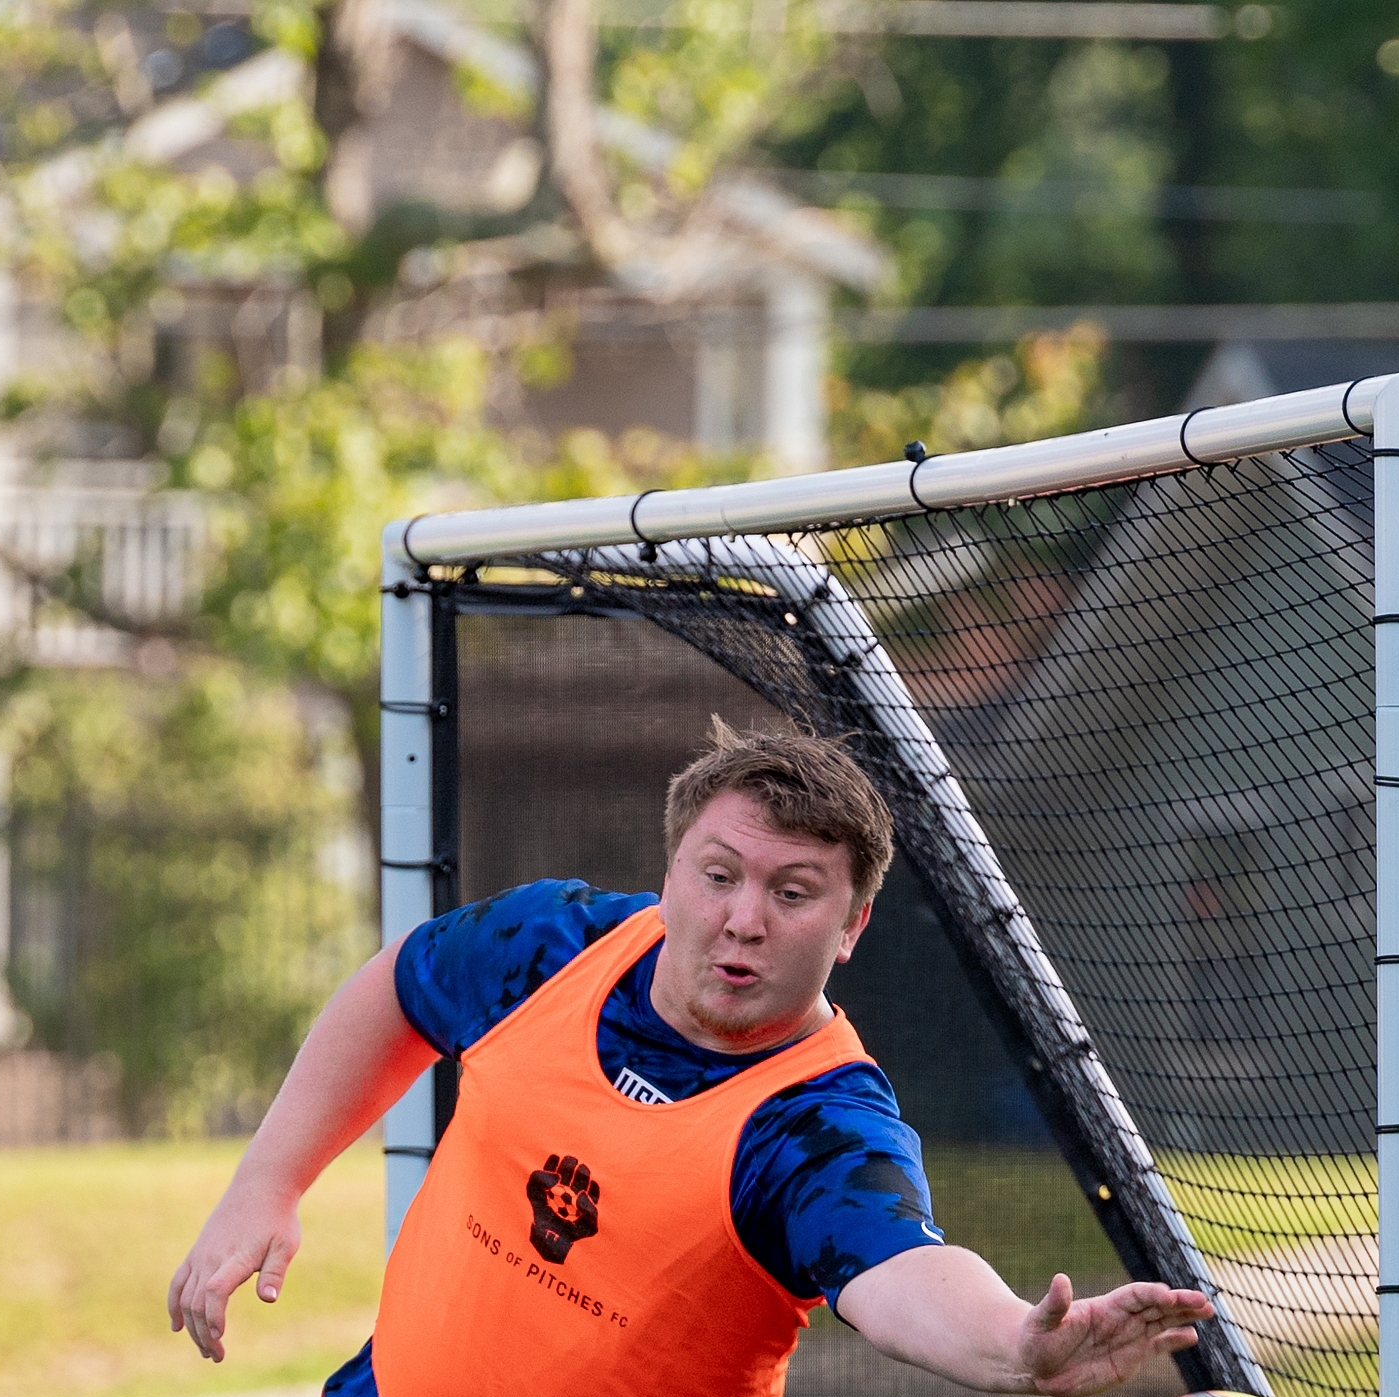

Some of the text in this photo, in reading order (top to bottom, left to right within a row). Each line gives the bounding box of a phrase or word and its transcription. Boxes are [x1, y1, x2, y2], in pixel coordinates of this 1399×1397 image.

[466, 1214, 629, 1328] SONS OF PITCHES FC
